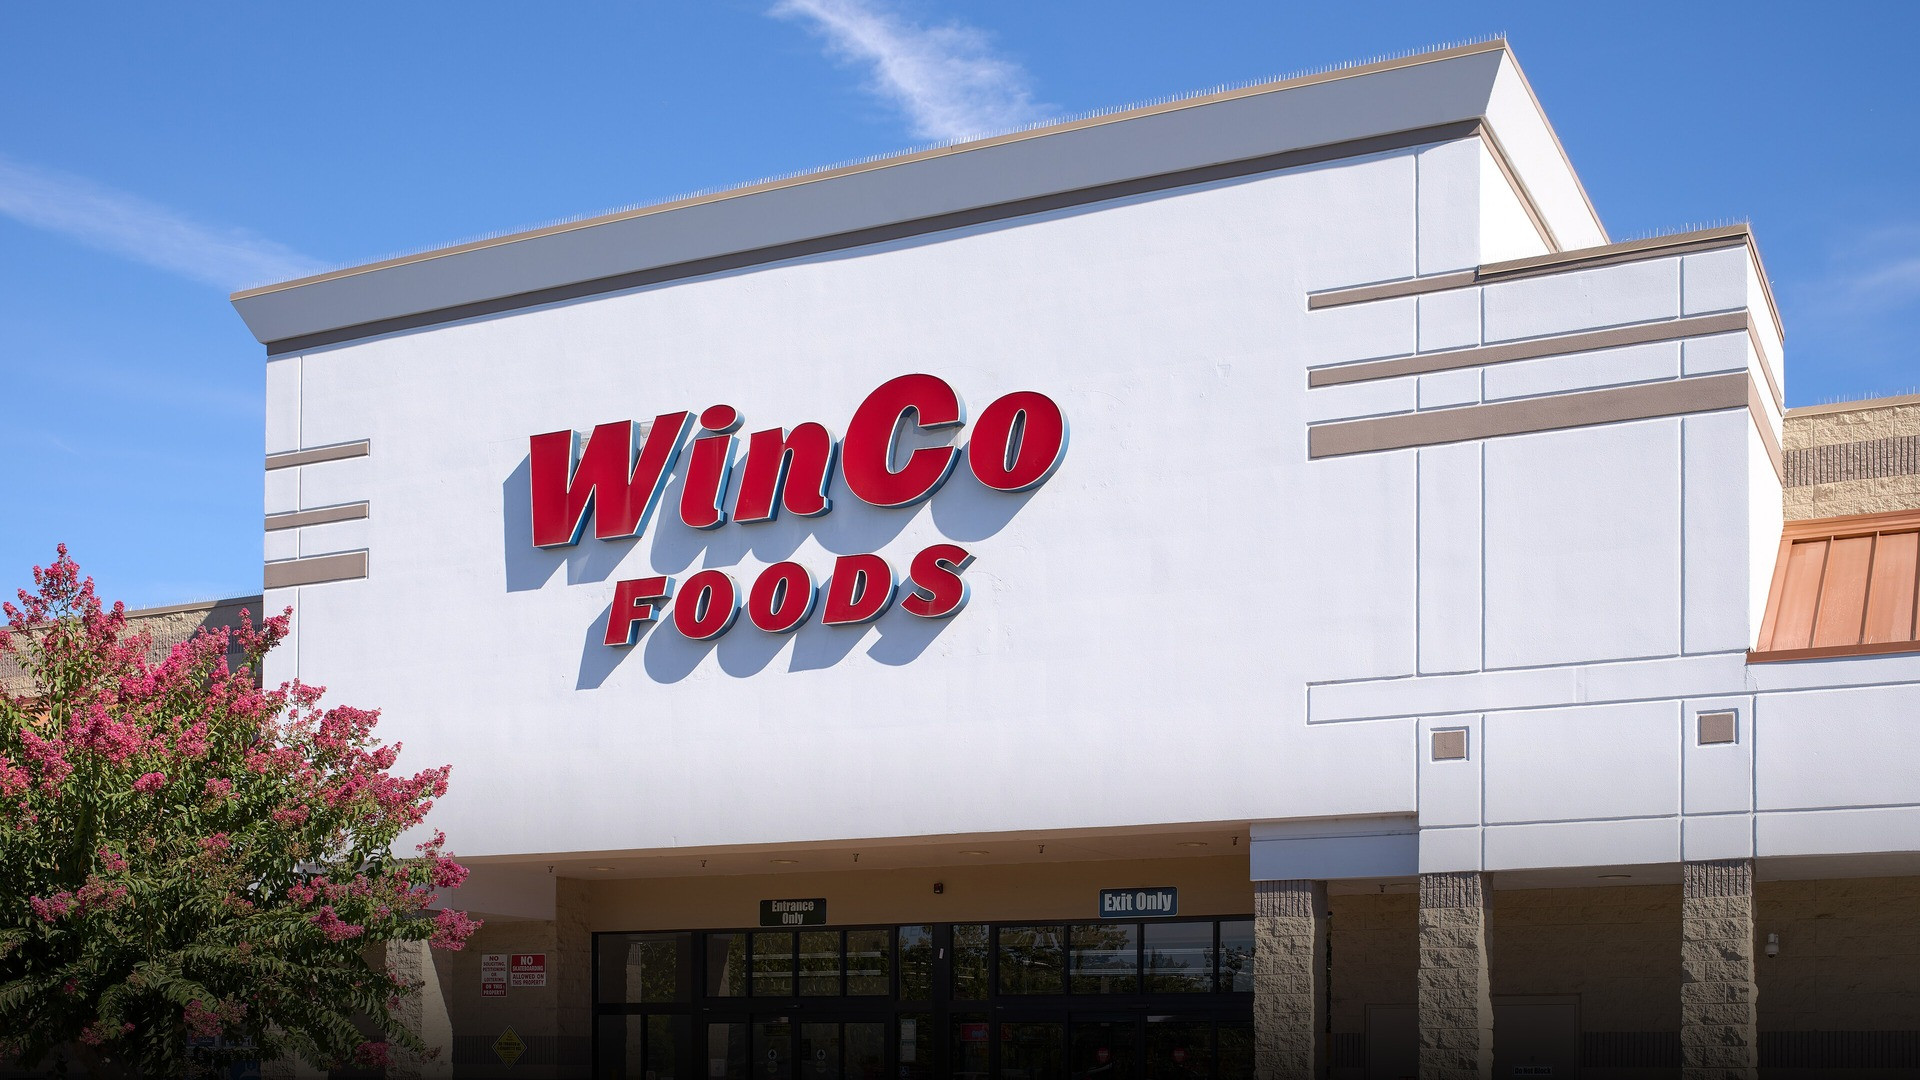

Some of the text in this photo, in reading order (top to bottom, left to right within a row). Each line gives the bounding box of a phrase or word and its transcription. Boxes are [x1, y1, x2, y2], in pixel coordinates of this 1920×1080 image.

[529, 373, 1069, 550] WinCo
[603, 543, 976, 647] FOODS
[771, 900, 815, 925] Entrance Only
[1104, 891, 1172, 912] Exit Only
[520, 956, 533, 966] NO
